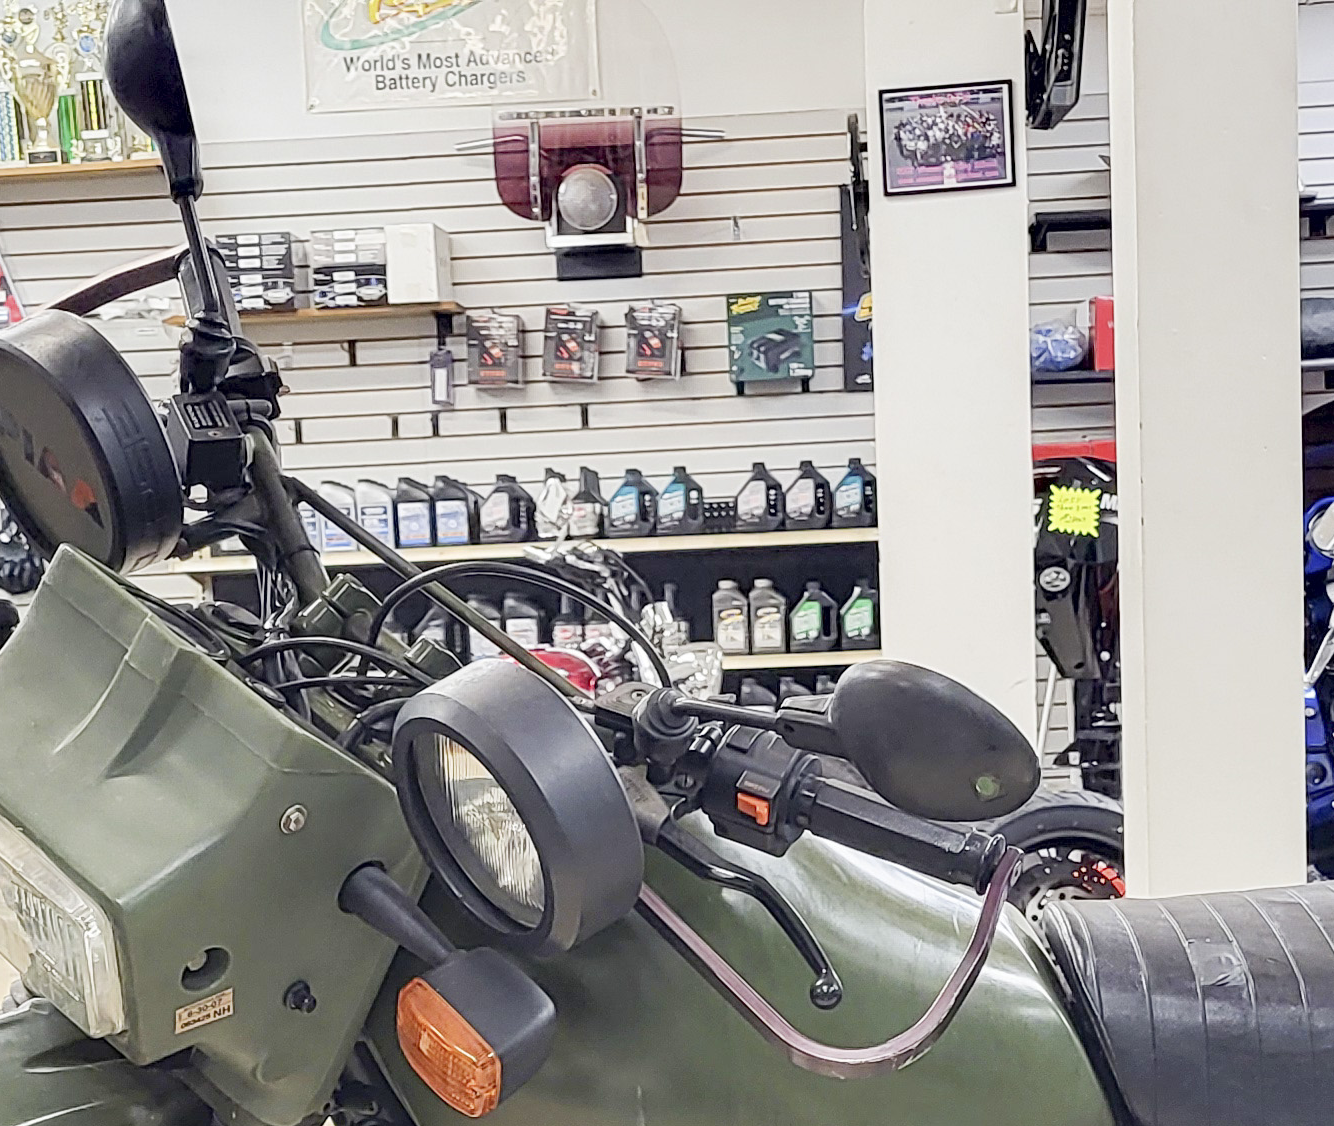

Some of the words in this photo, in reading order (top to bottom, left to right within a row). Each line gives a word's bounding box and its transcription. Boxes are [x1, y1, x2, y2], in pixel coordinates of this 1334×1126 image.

[343, 53, 411, 73] World's
[417, 52, 461, 70] Most
[467, 48, 556, 68] Advanced
[375, 72, 438, 93] Battery
[445, 69, 527, 90] Chargers
[213, 1005, 231, 1019] NH
